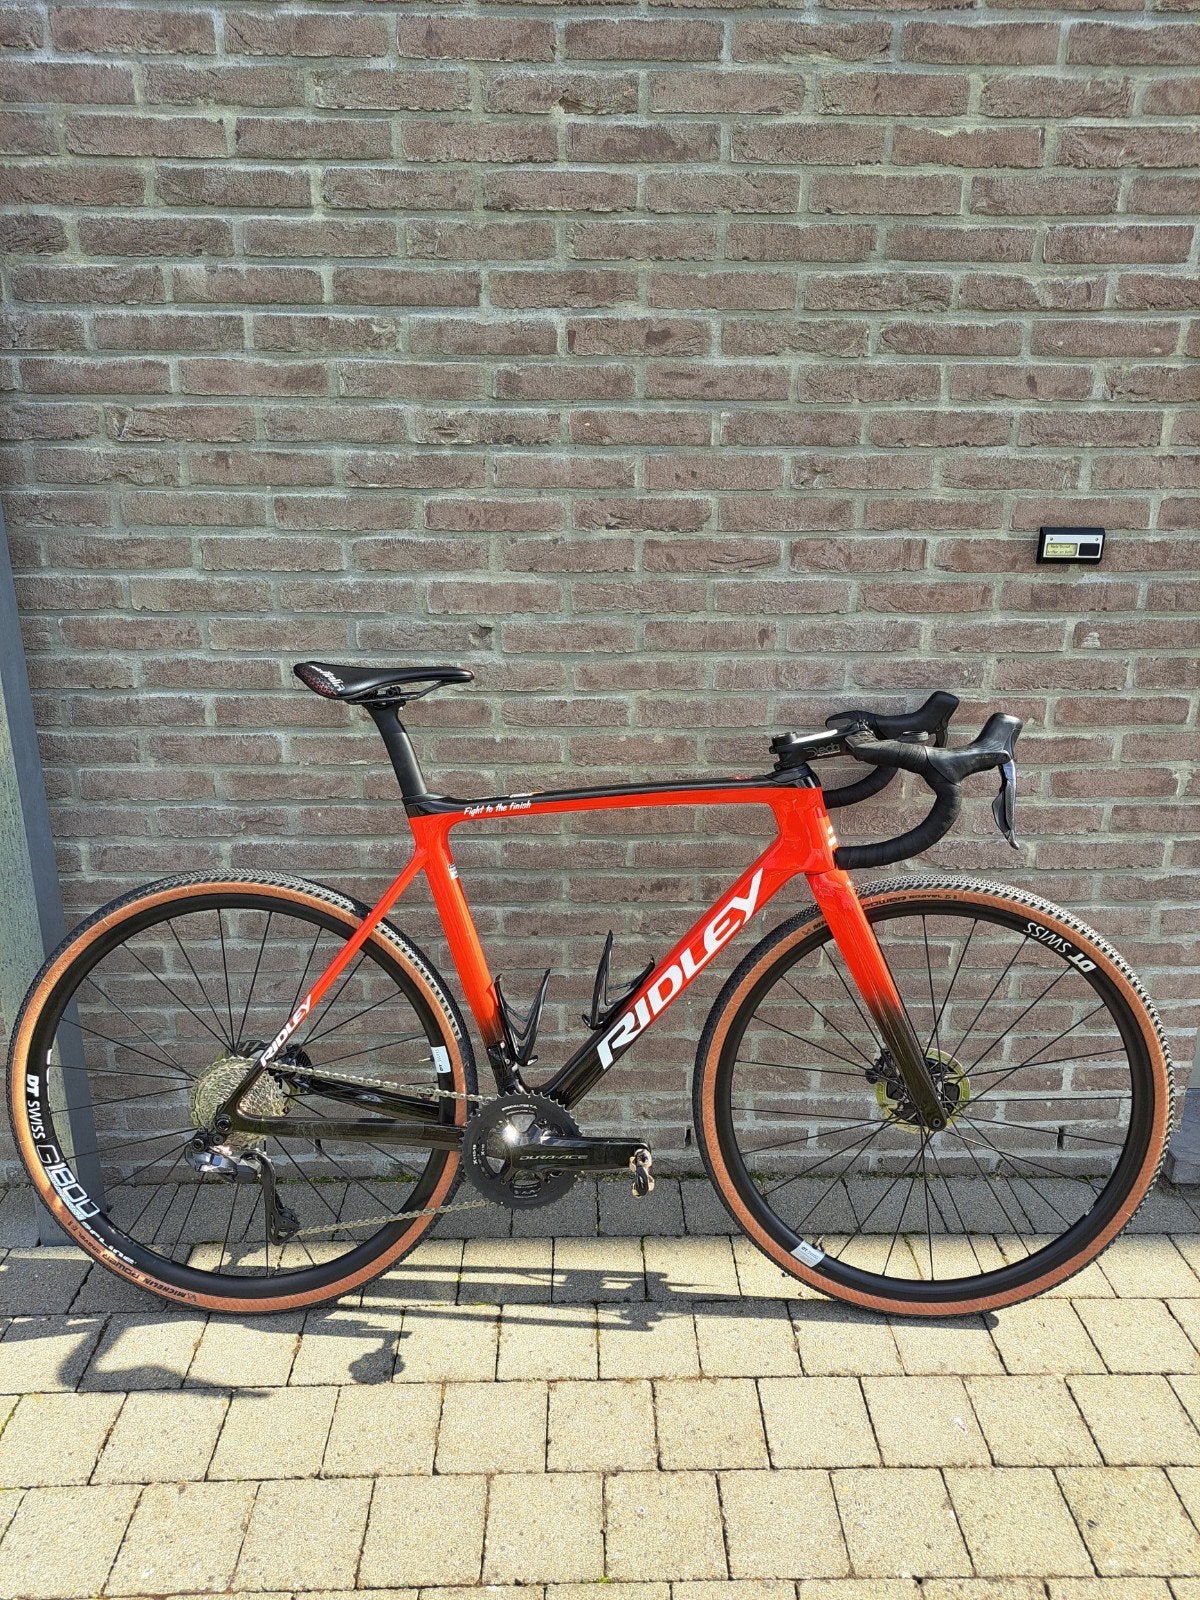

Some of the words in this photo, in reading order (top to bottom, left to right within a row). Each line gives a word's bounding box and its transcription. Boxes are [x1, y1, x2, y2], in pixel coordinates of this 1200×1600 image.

[463, 806, 484, 817] Fight
[486, 804, 493, 812] to
[495, 803, 507, 812] the
[509, 800, 531, 810] finish
[1022, 922, 1073, 954] SWISS
[596, 867, 763, 1070] RIDLEY
[1068, 949, 1097, 973] DT
[260, 993, 312, 1067] RIDLEY
[26, 1073, 40, 1098] DT
[27, 1100, 46, 1140] SWISS
[142, 1275, 187, 1298] MICHELIN
